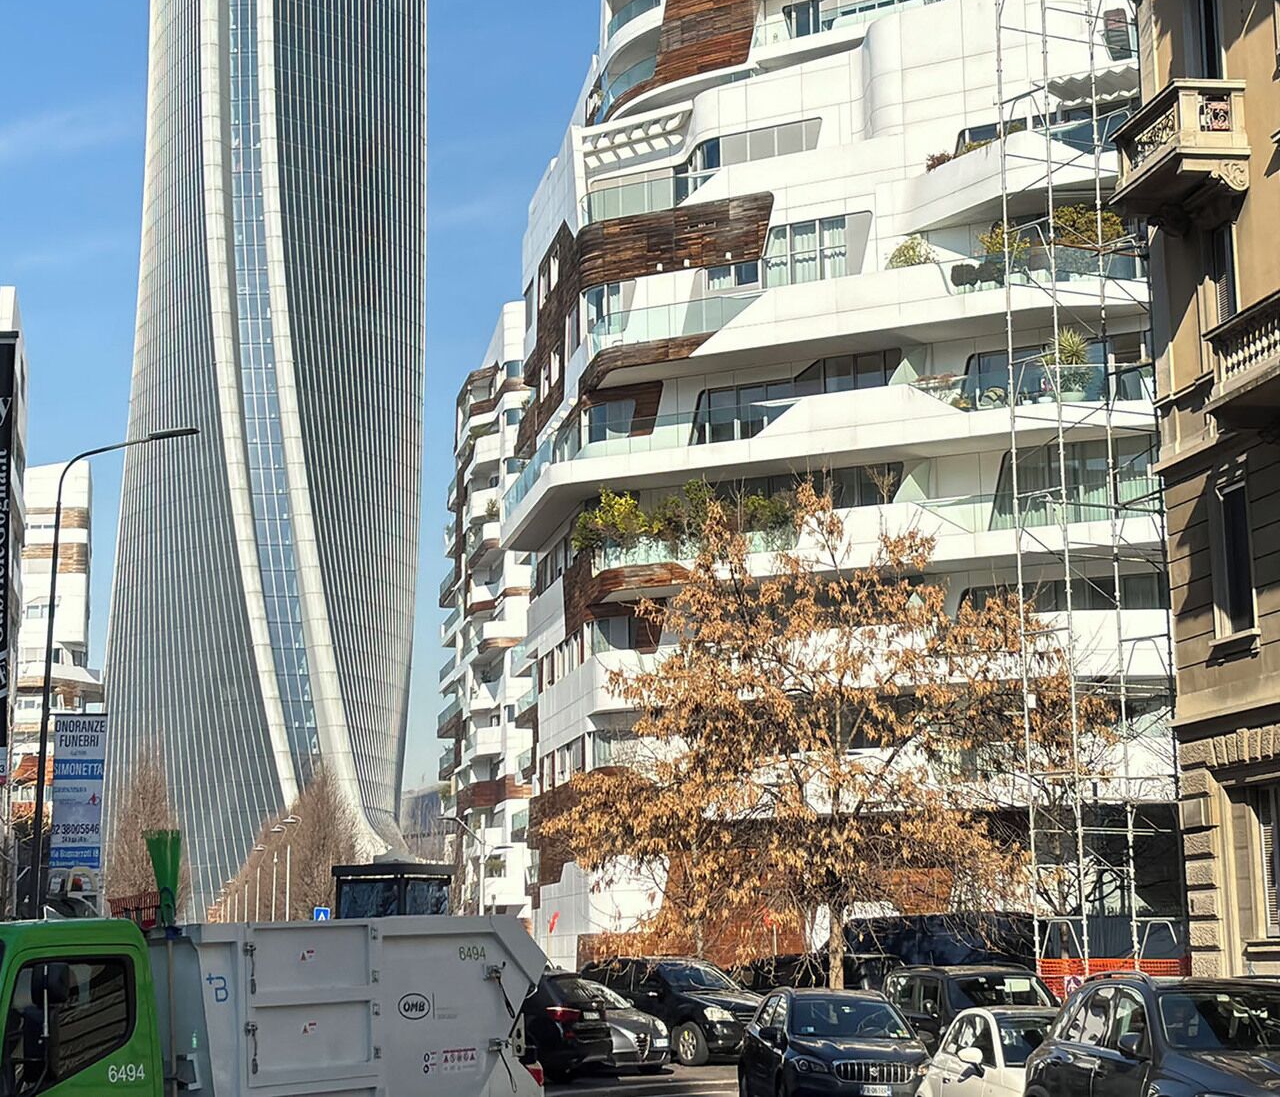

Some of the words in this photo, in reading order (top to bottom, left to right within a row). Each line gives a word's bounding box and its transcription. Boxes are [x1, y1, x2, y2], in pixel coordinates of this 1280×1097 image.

[55, 719, 105, 733] ONORANZE
[59, 734, 99, 748] FUNEBRI
[54, 762, 103, 776] SIMONETTA
[458, 946, 487, 961] 6494
[403, 1000, 426, 1013] OMB
[108, 1063, 145, 1083] 6494
